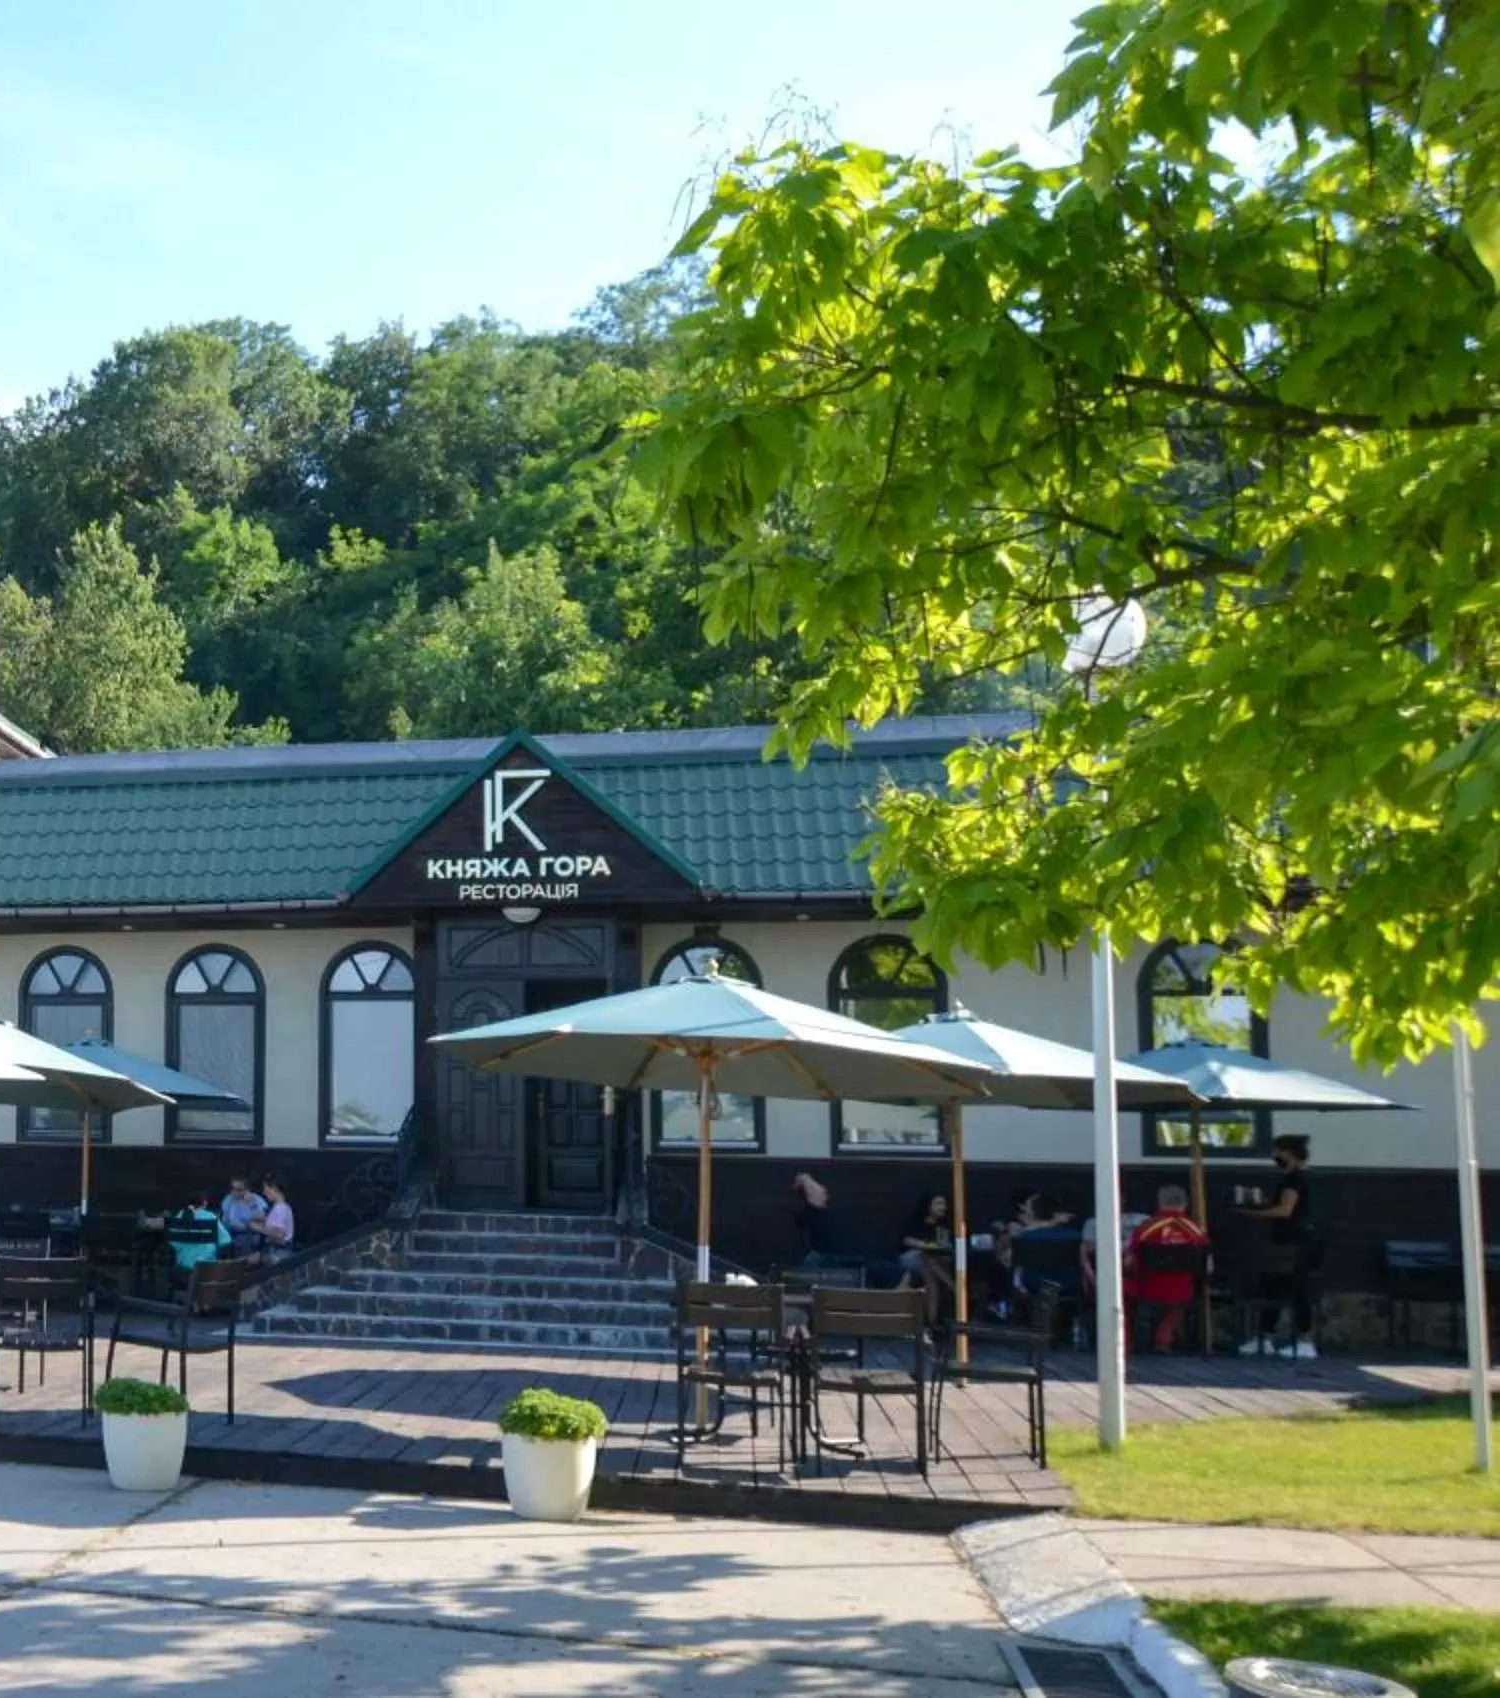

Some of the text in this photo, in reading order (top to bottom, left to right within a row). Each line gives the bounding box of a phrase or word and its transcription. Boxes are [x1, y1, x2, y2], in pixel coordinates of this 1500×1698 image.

[427, 855, 612, 879] КНЯЖА ГОРА
[459, 883, 579, 900] РЕСТОРАЦІЯ
